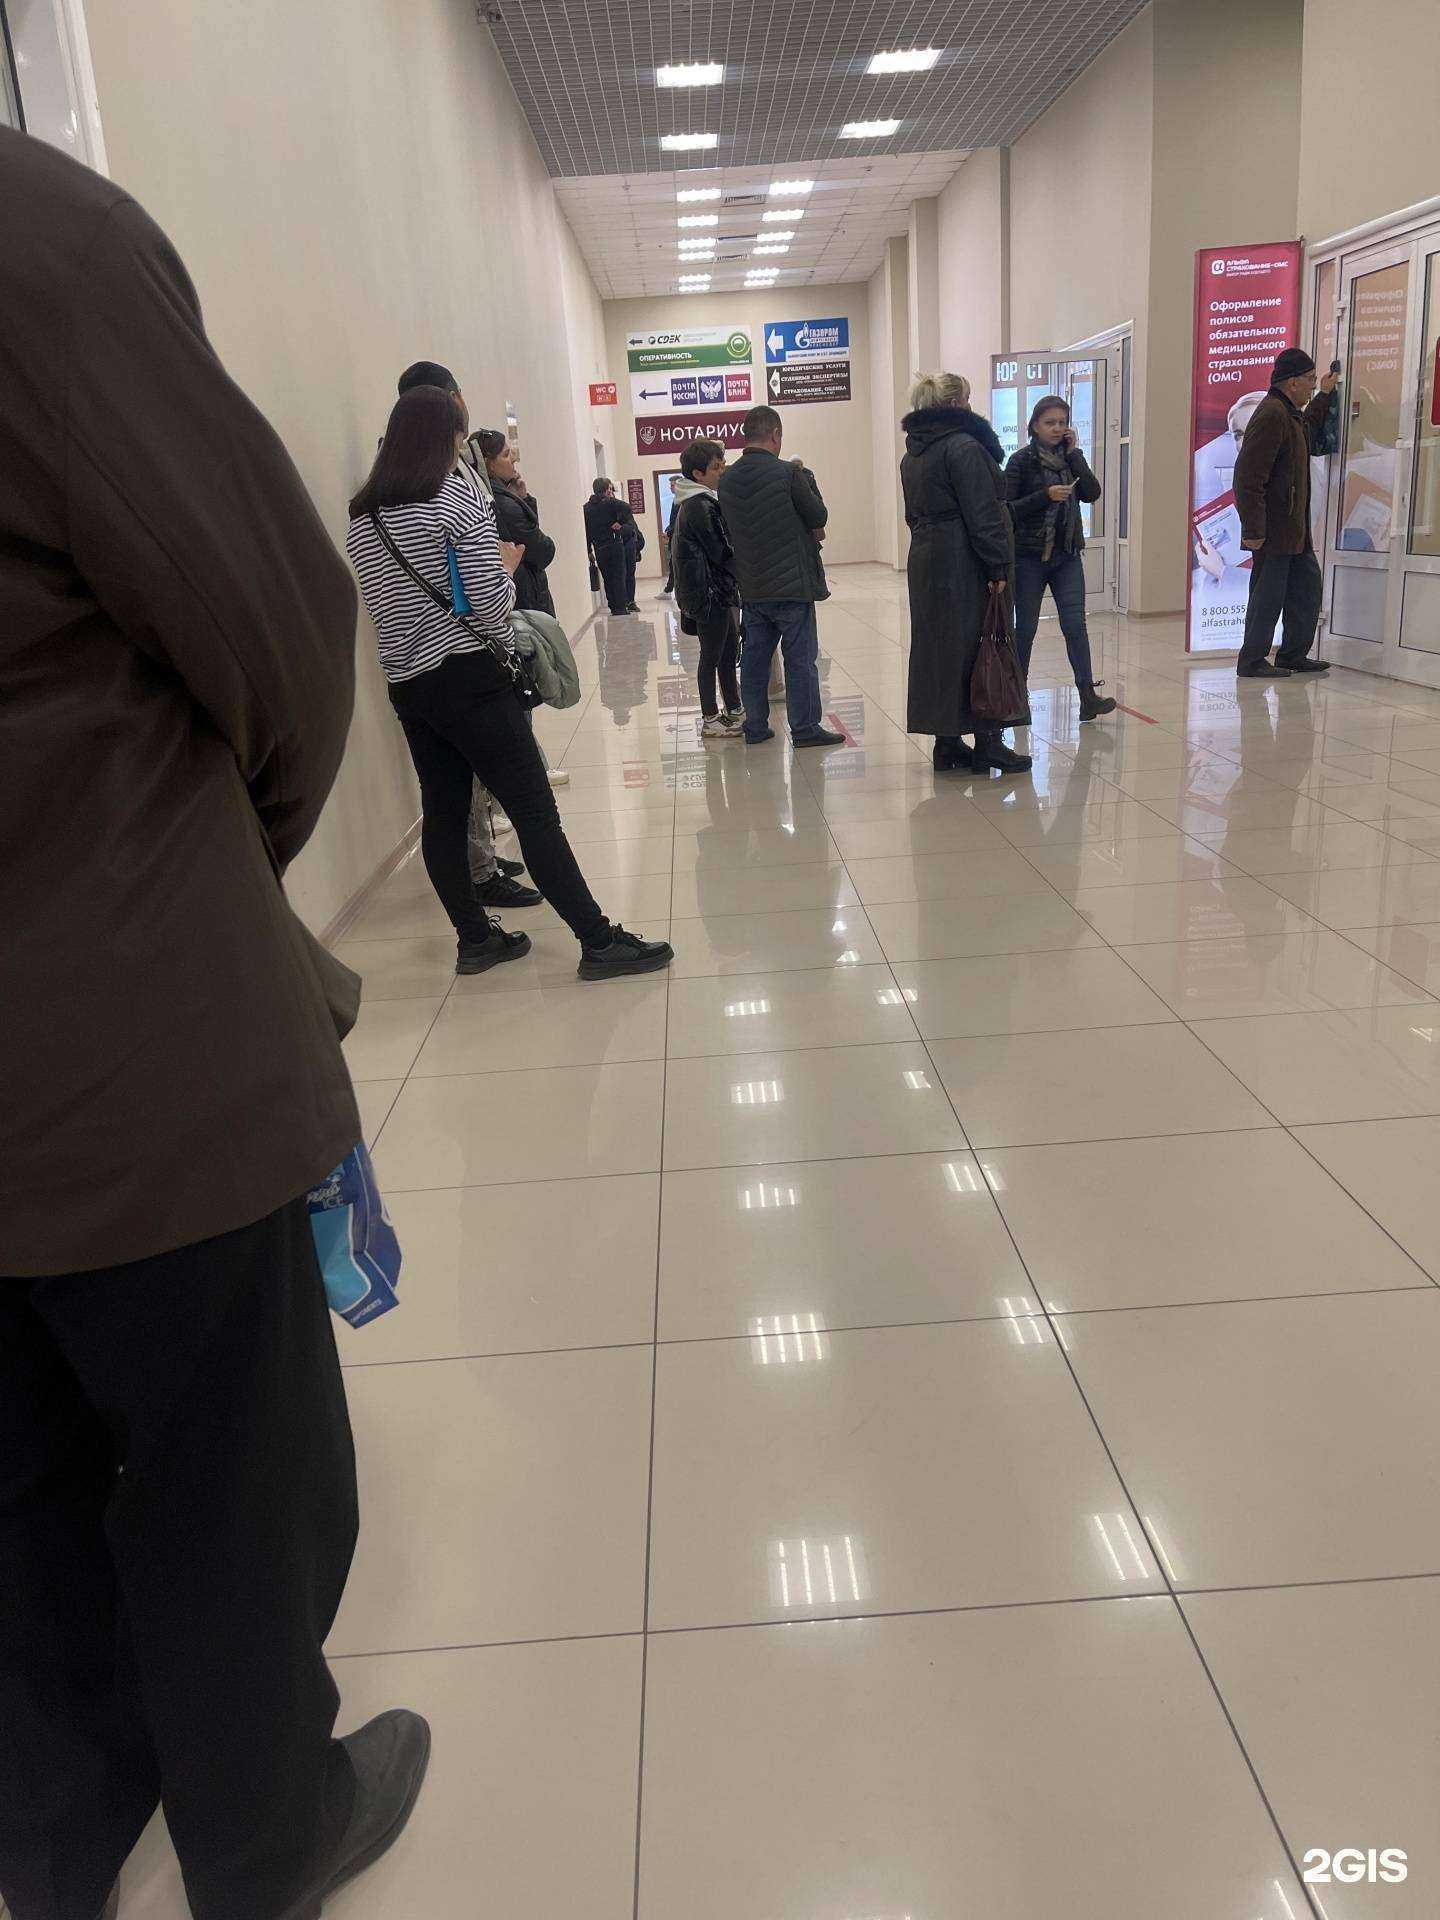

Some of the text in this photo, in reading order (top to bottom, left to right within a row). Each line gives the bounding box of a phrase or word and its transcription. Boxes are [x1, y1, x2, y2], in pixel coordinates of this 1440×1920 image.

[1210, 297, 1282, 312] Оформление
[1209, 314, 1254, 326] полисов
[1209, 326, 1287, 340] обязательного
[657, 334, 681, 345] CDEK
[1208, 340, 1286, 355] медицинского
[639, 352, 692, 362] ОПЕРАТИВНОСТЬ
[1208, 355, 1275, 371] страхования
[1208, 370, 1242, 384] (ОМС)
[672, 382, 696, 391] ПОЧТА
[727, 380, 749, 388] ПОЧТА
[672, 392, 697, 401] РОССИИ
[727, 388, 747, 397] БАНК
[1201, 604, 1246, 616] 8 800 555
